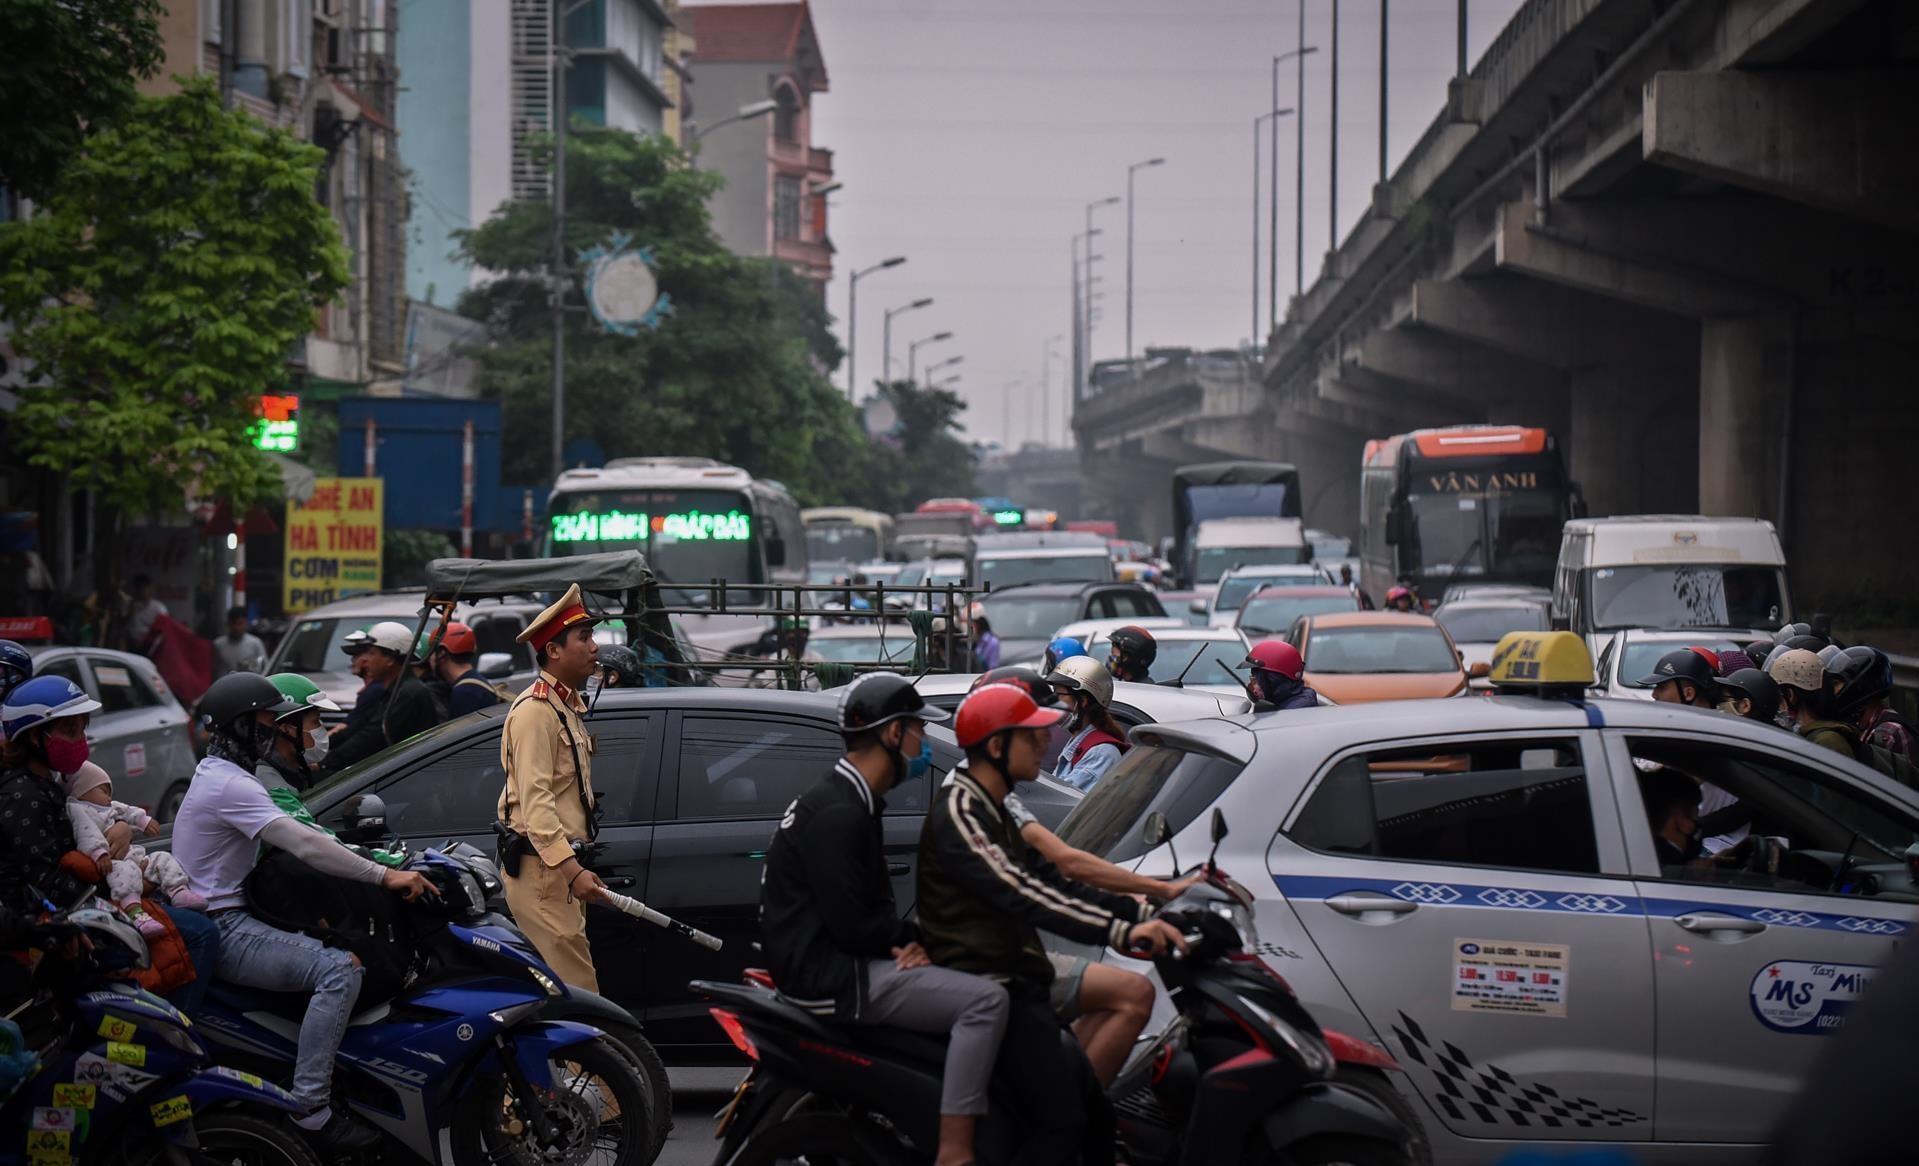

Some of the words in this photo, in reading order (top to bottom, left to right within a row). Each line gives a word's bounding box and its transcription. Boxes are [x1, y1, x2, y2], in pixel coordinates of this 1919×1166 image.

[1430, 471, 1480, 492] VÂN
[1488, 471, 1537, 489] ANH
[349, 486, 375, 511] AN
[290, 519, 319, 550] HÀ
[290, 557, 339, 579] CƠM
[472, 936, 501, 953] YAMAHA
[1765, 979, 1814, 1010] MS
